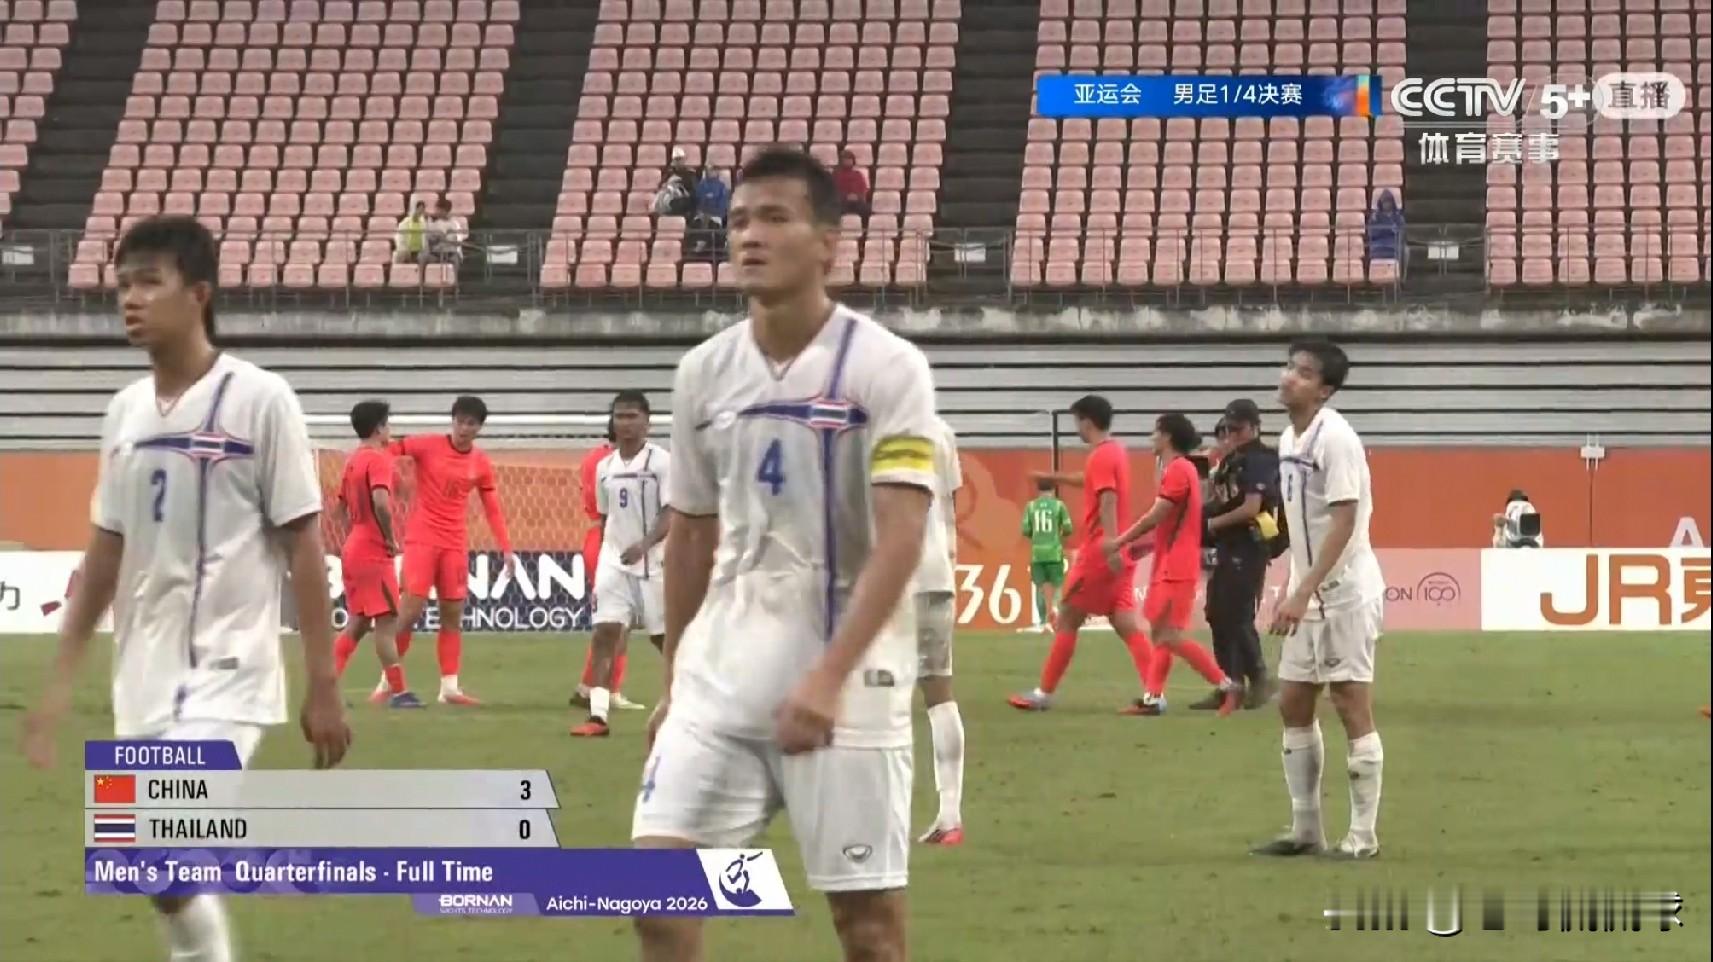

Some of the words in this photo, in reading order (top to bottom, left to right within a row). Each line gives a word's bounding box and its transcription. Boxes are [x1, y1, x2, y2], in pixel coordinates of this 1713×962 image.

[757, 439, 785, 496] 4
[150, 468, 168, 522] 2
[618, 487, 628, 508] 9
[1033, 509, 1054, 532] 16
[1384, 586, 1413, 602] ON
